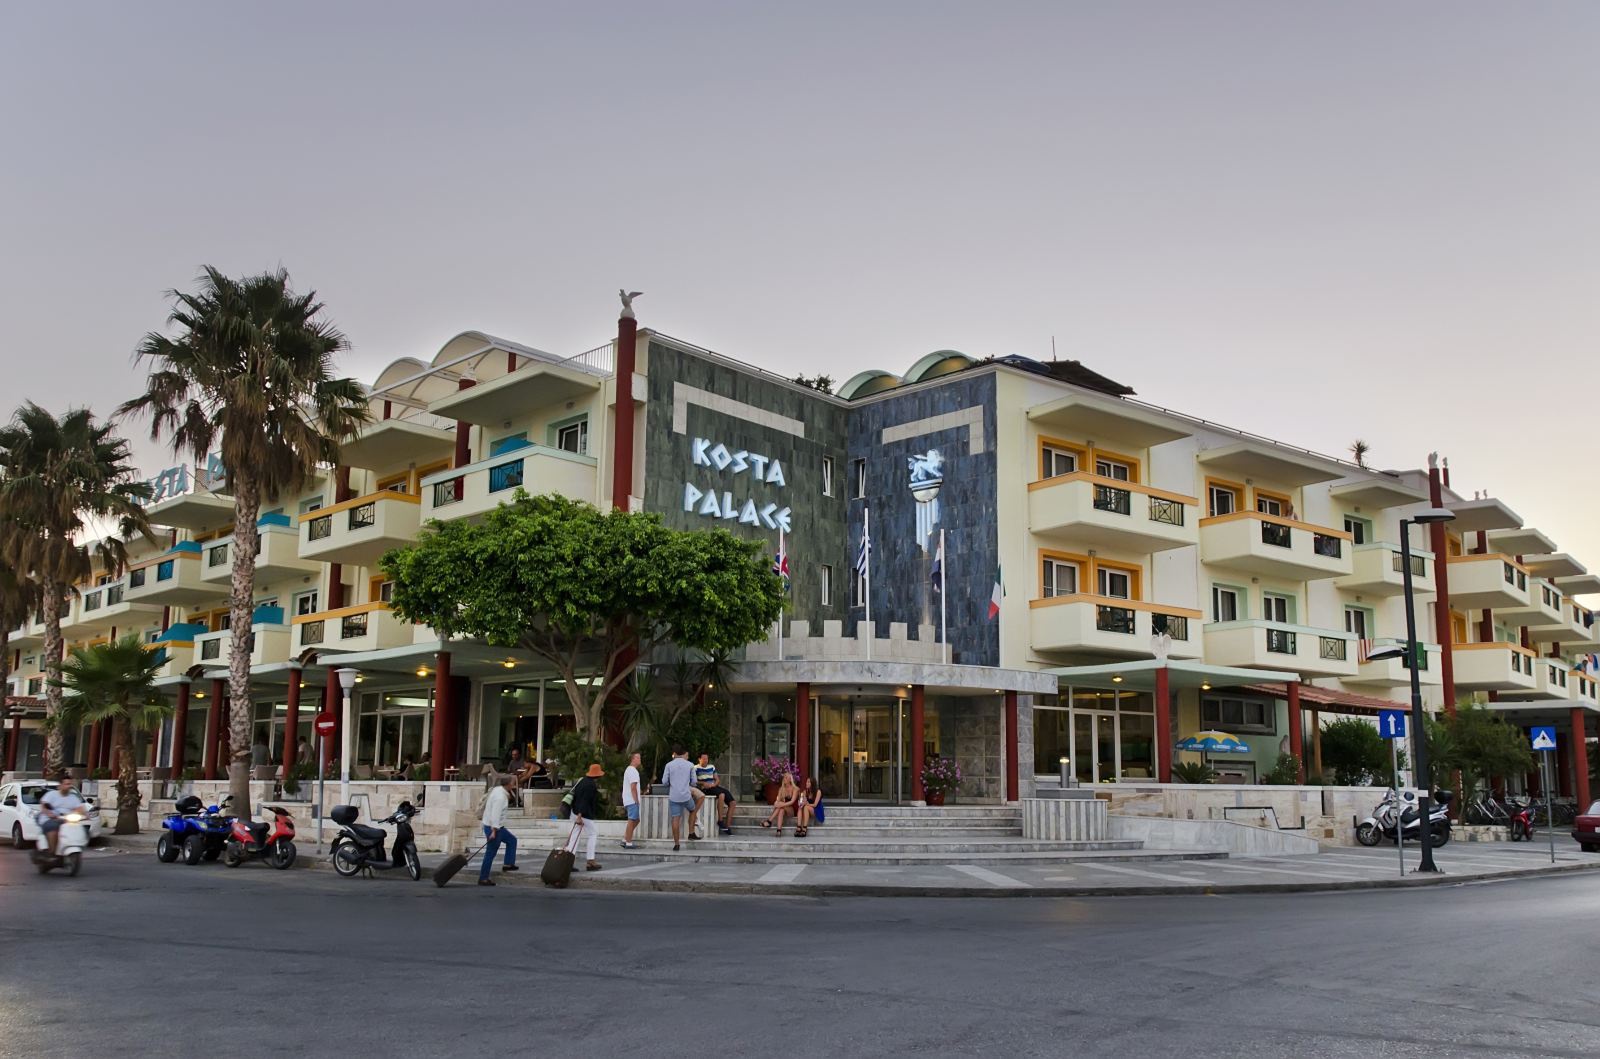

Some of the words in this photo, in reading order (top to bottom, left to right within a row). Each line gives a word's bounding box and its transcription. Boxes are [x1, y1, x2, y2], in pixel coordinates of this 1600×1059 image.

[130, 463, 188, 505] STA
[692, 437, 786, 487] KOSTA
[684, 482, 792, 533] PALACE
